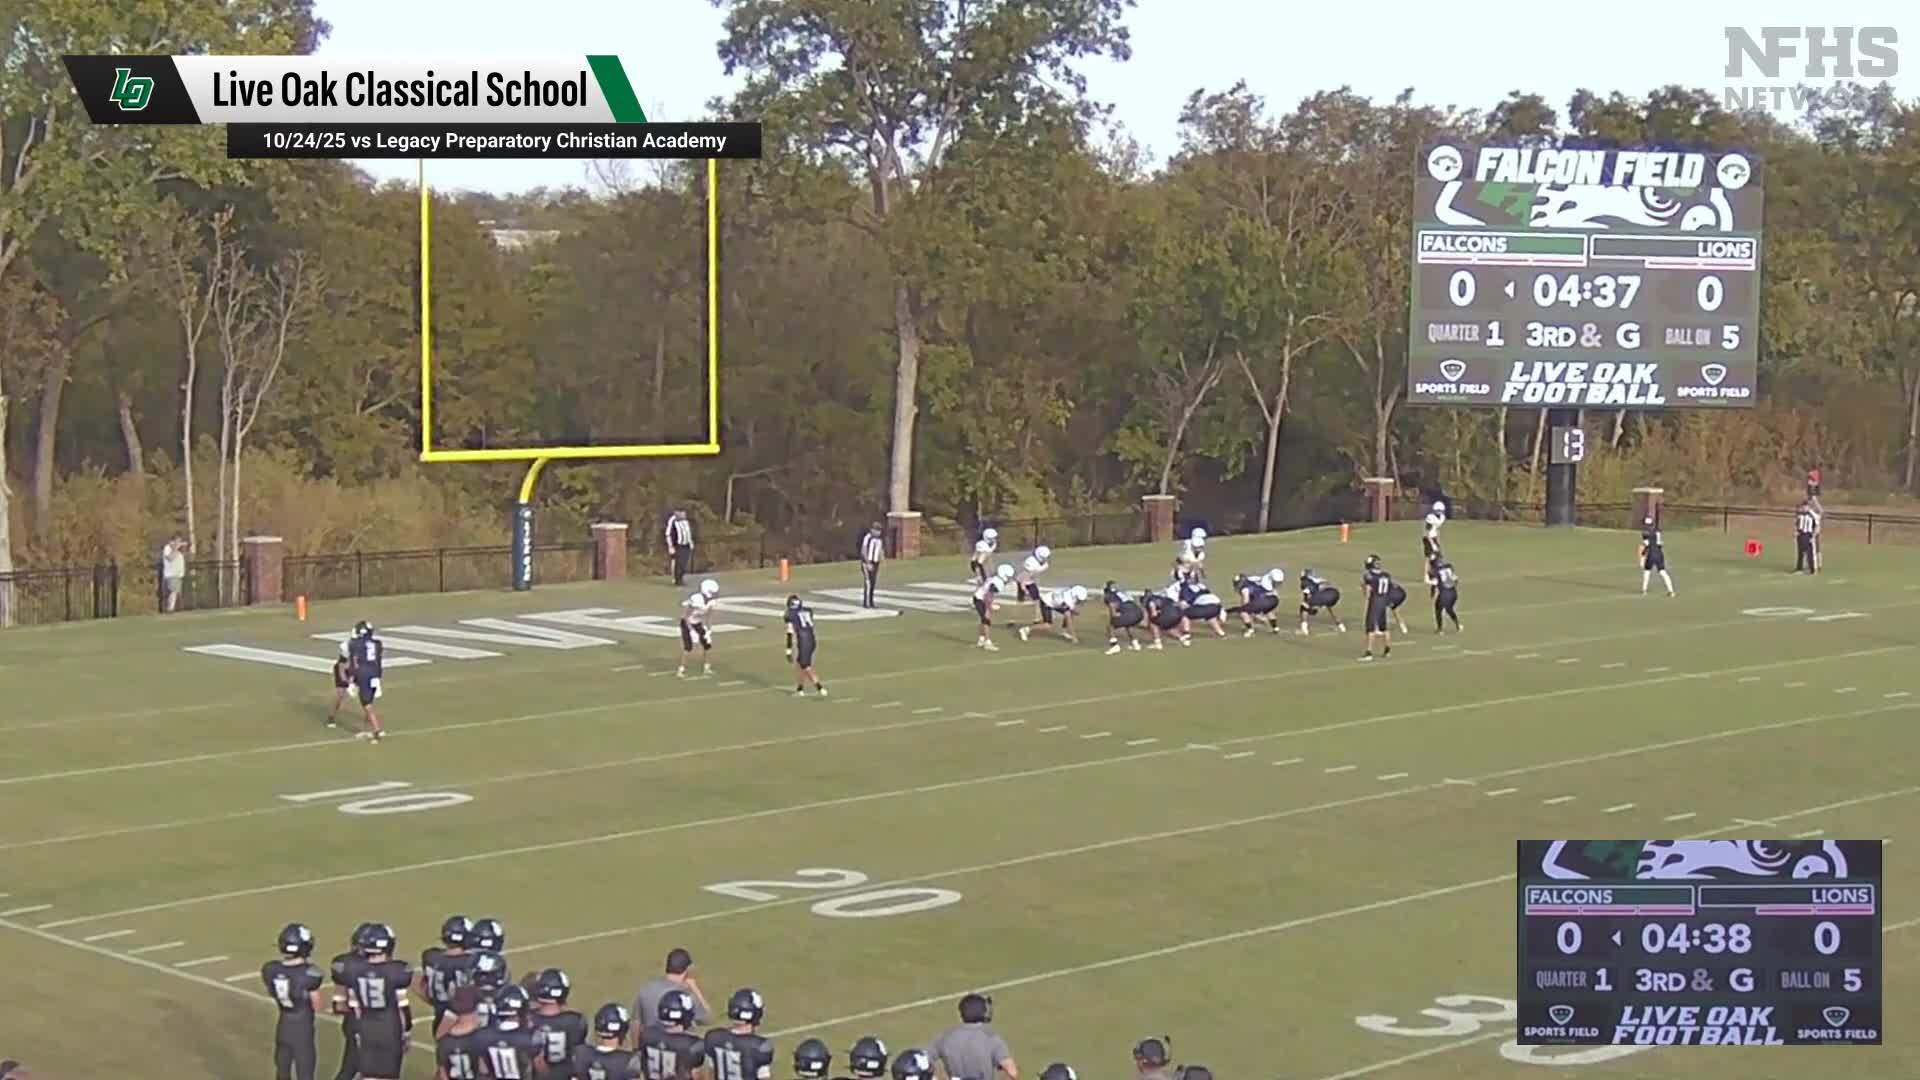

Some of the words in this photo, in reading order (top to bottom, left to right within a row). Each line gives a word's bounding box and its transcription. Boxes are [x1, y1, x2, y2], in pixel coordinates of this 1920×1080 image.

[1475, 147, 1606, 185] FALCON
[1612, 152, 1705, 187] FIELD
[1422, 235, 1507, 253] FALCONS
[1698, 242, 1751, 258] LIONS
[1449, 270, 1476, 307] 0
[1533, 273, 1641, 309] 04:37
[1697, 275, 1723, 311] 0
[1428, 323, 1480, 343] QUARTER
[1486, 321, 1504, 346] 1
[1526, 322, 1576, 347] 3RD
[1580, 323, 1602, 347] &
[1615, 322, 1641, 349] G
[1665, 328, 1693, 345] BALL
[1721, 325, 1740, 350] 5
[1510, 361, 1589, 383] LIVE
[1592, 362, 1658, 384] OAK
[1415, 383, 1457, 394] SPORTS
[1459, 384, 1490, 395] FIELD
[1501, 382, 1666, 404] FOOTBALL
[1677, 387, 1718, 397] SPORTS
[1719, 387, 1750, 397] FIELD
[1563, 428, 1584, 462] 13
[702, 867, 963, 917] 20
